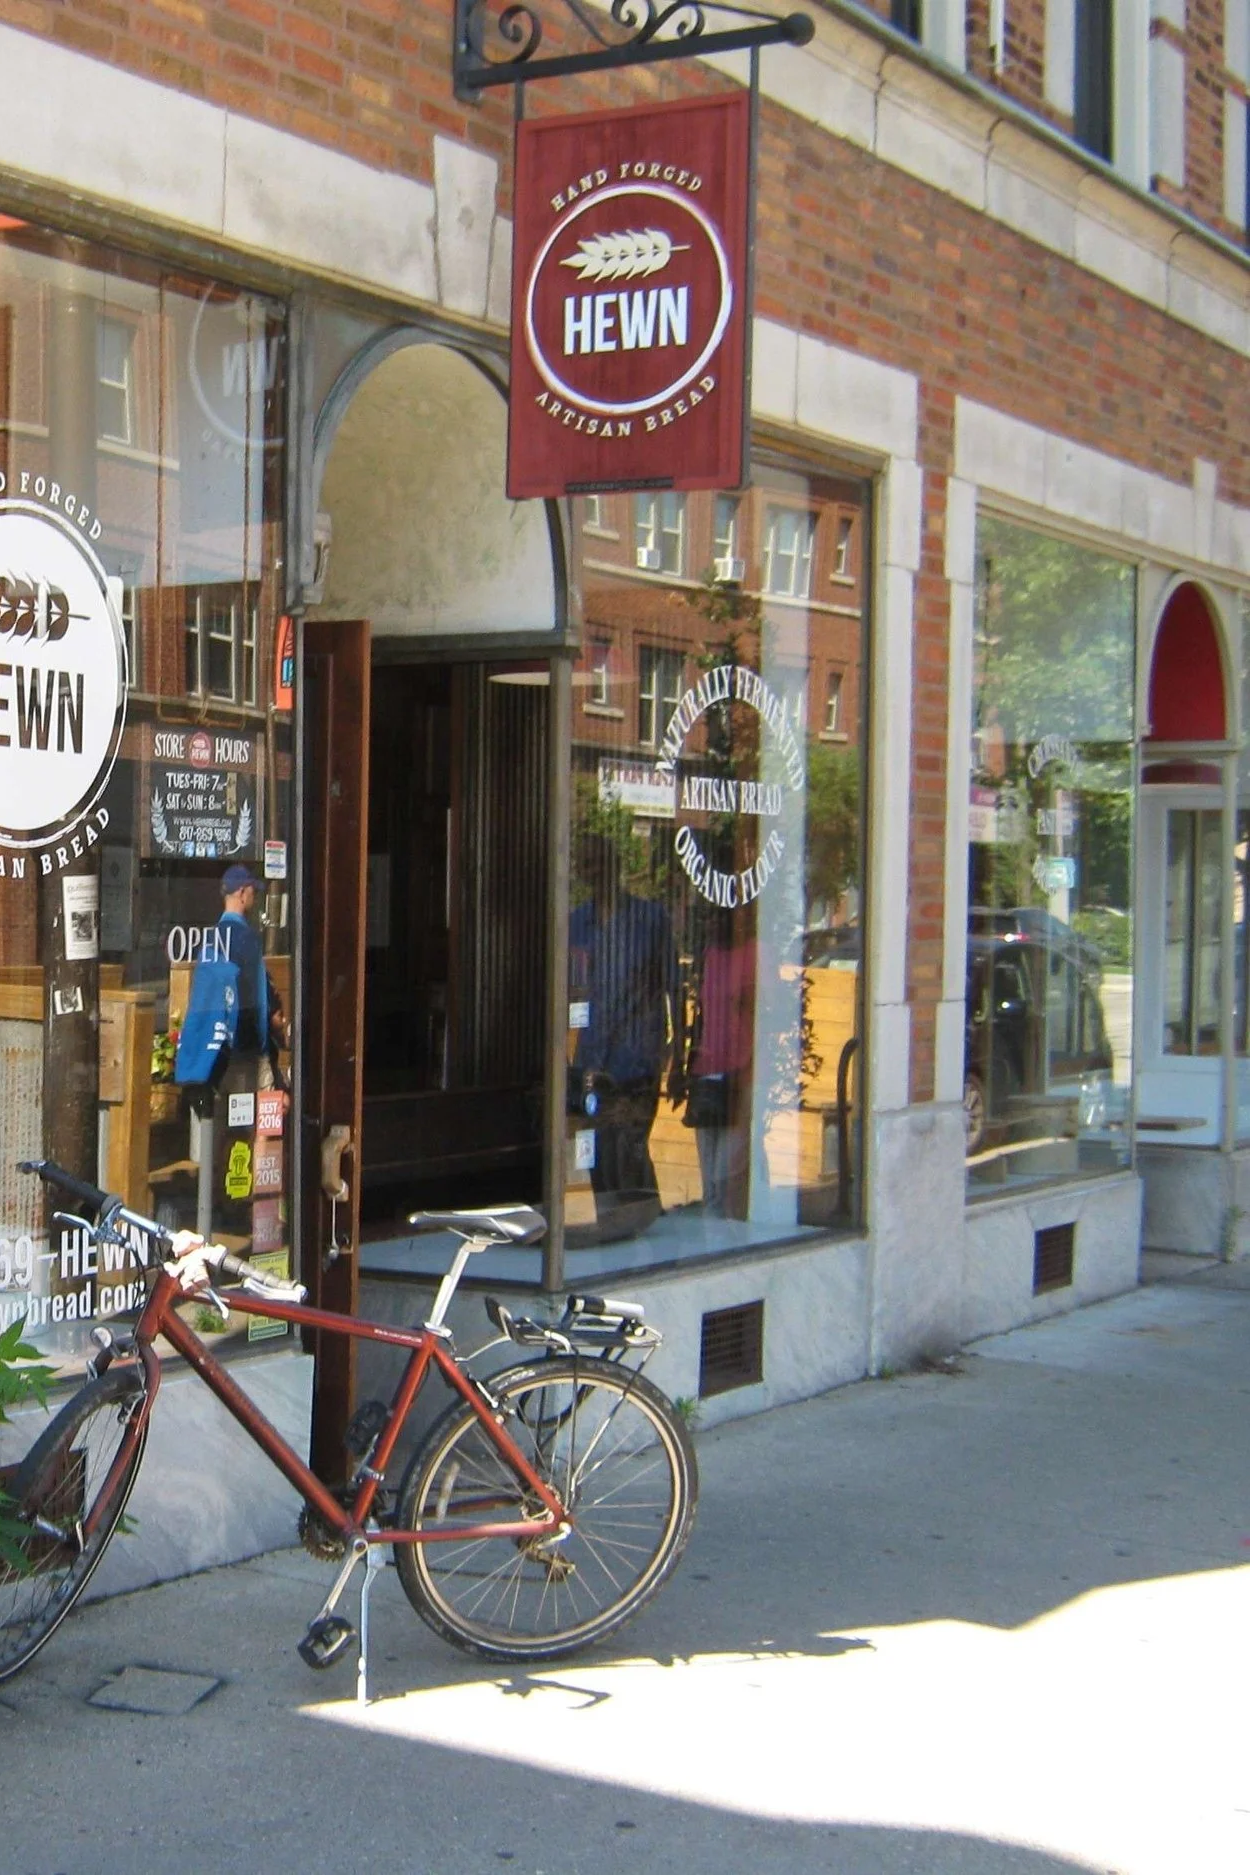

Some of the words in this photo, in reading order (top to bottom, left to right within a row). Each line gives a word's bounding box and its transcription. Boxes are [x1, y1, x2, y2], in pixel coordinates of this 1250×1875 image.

[551, 168, 608, 212] HAND
[620, 161, 703, 193] FORGED
[563, 286, 688, 356] HEWN
[535, 390, 632, 438] ARTISAN
[645, 374, 717, 433] BREAD
[20, 471, 103, 542] FORGED
[655, 664, 734, 772] NATURALLY
[735, 665, 805, 792] FERMENTED
[154, 733, 186, 759] STORE
[215, 737, 250, 764] HOURS
[166, 792, 181, 810] SAT
[681, 776, 738, 813] ARTISAN
[740, 780, 783, 815] BREAD
[40, 806, 110, 876] BREAD
[674, 825, 738, 909] ORGANIC
[742, 829, 786, 906] FLOUR
[167, 925, 232, 963] OPEN
[258, 1102, 278, 1114] BEST
[258, 1114, 282, 1129] 2016
[255, 1169, 281, 1186] 2015
[256, 1156, 276, 1169] BEST
